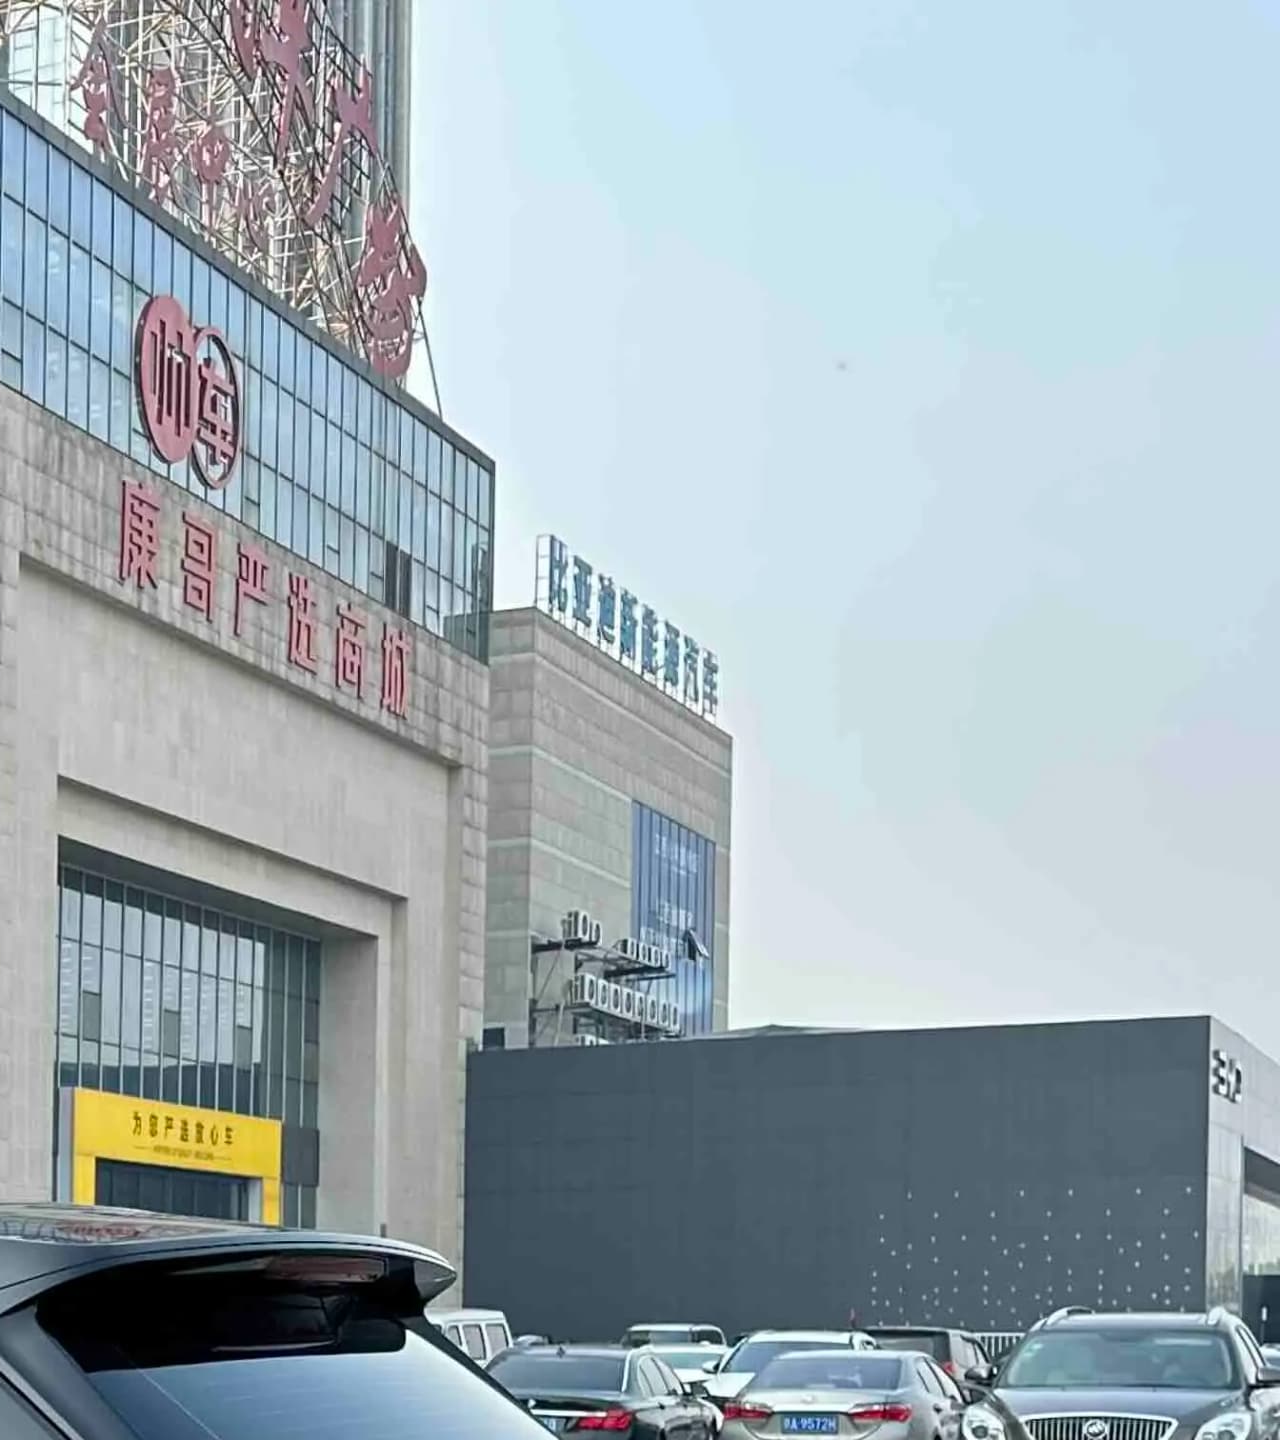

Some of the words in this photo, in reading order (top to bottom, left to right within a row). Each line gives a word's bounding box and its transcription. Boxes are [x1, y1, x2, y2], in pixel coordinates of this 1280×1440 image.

[118, 478, 411, 722] 康哥严选商城
[132, 1111, 234, 1146] 为您严选放心车
